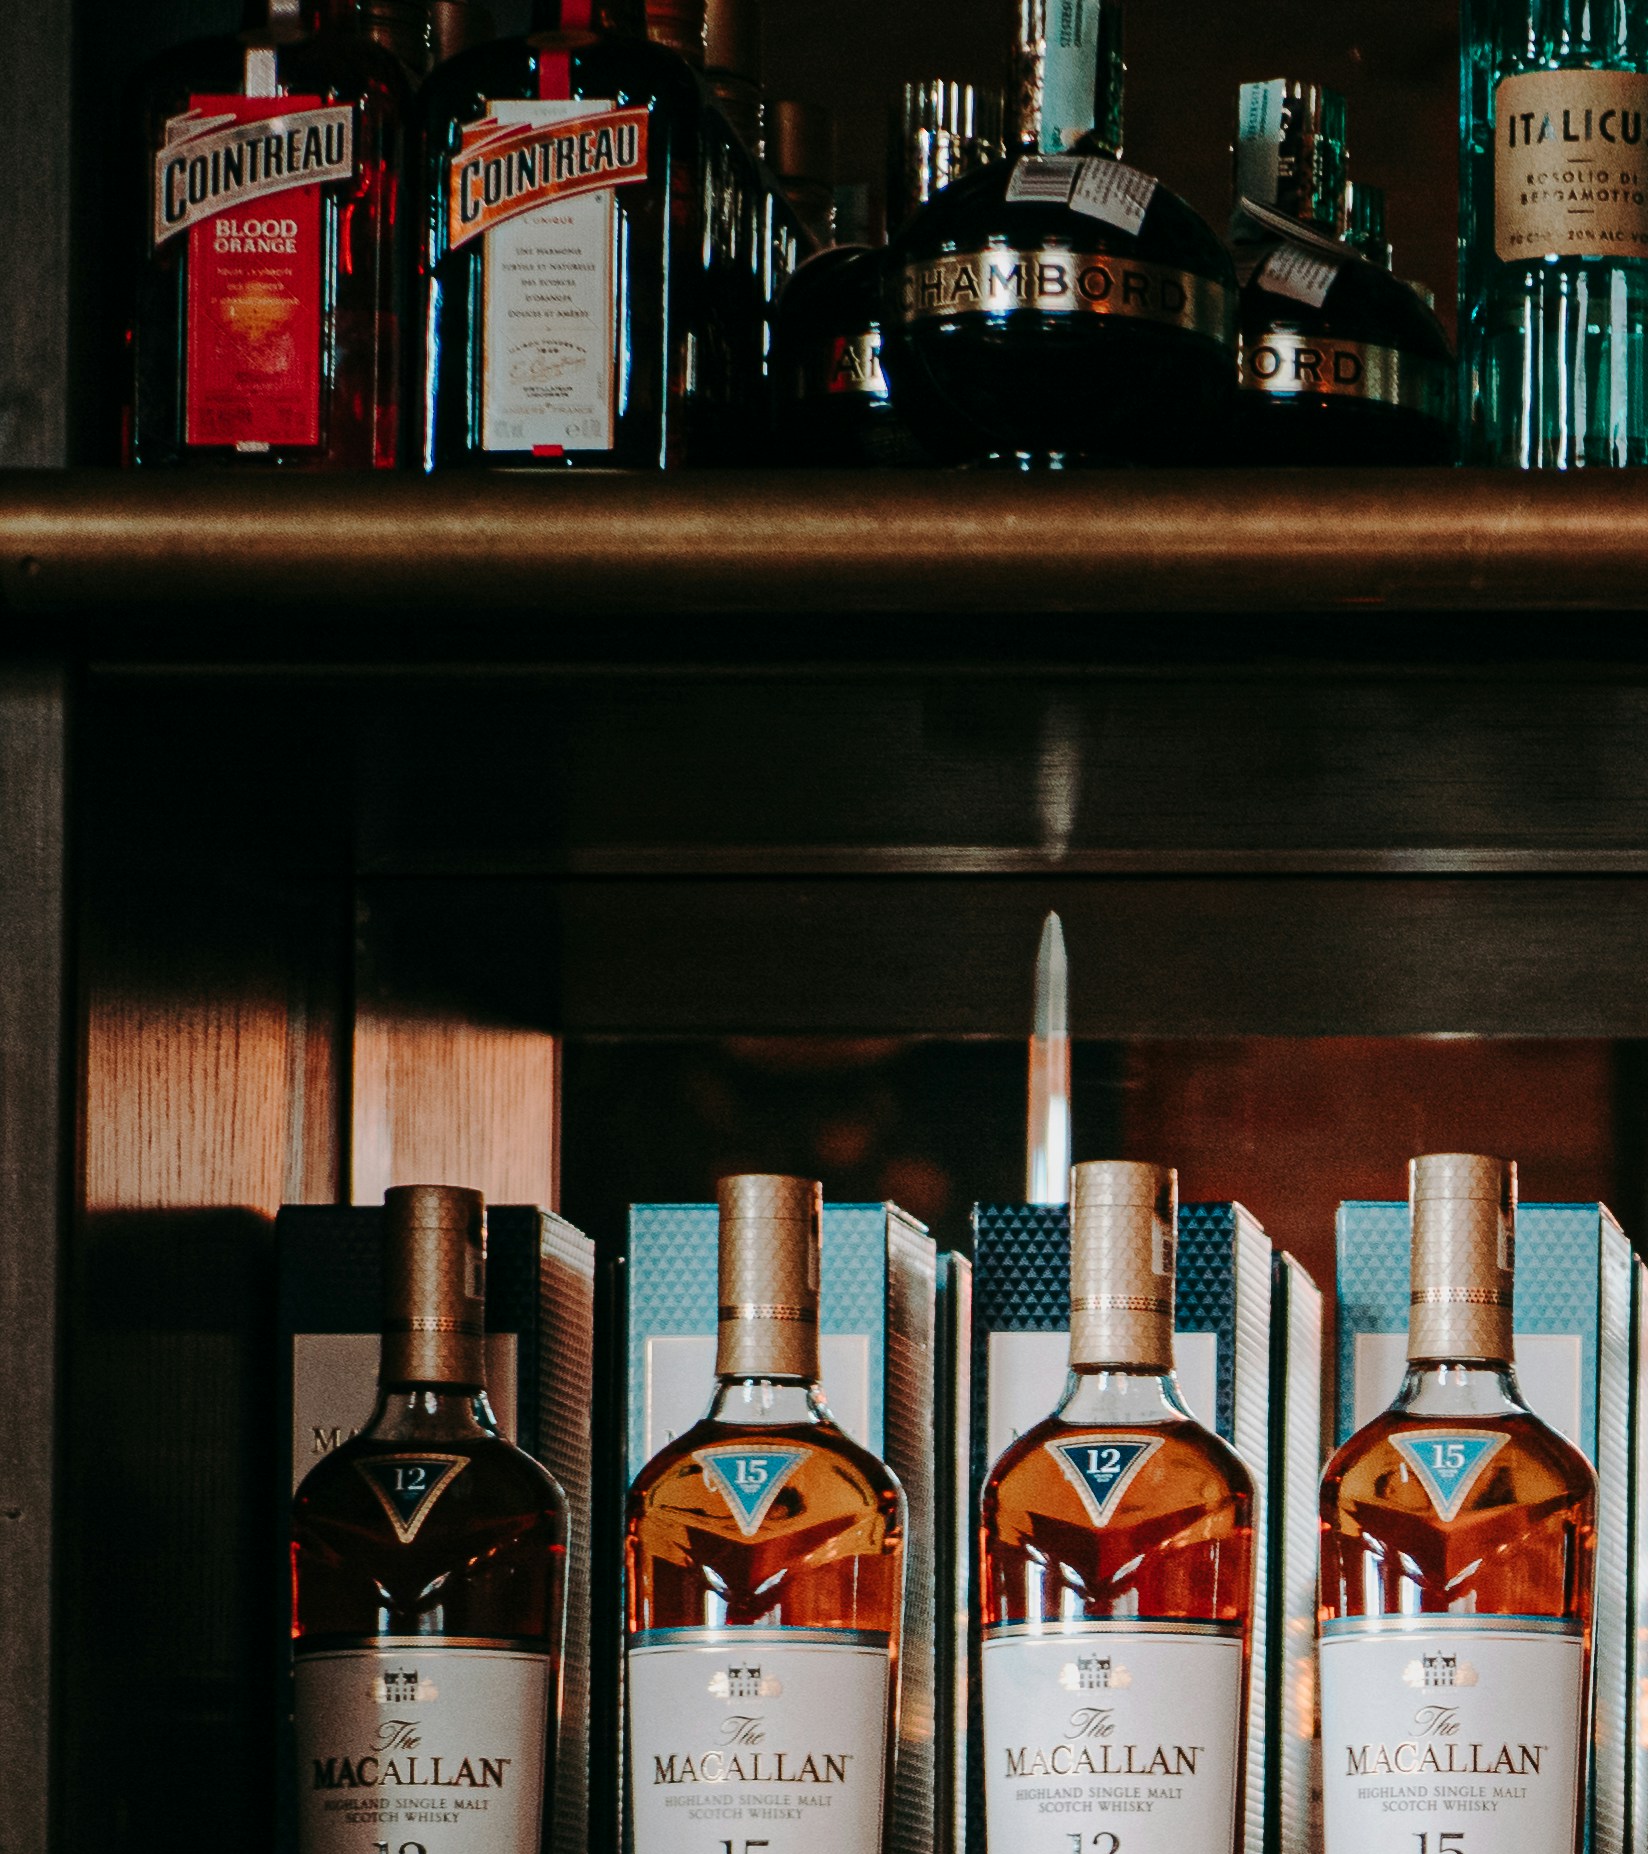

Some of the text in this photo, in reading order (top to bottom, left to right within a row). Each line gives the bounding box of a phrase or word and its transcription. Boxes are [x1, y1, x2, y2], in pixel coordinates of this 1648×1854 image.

[165, 122, 345, 223] COINTREAU
[461, 124, 638, 224] COINTREAU
[1527, 171, 1637, 185] ROSOLIO DI
[215, 218, 298, 238] BLOOD
[213, 238, 297, 254] ORANGE
[903, 263, 1187, 314] HAMBORD
[736, 1459, 769, 1485] 15
[1086, 1448, 1121, 1474] 12
[1432, 1444, 1466, 1469] 15
[395, 1467, 426, 1490] 12
[371, 1720, 423, 1752] The
[714, 1716, 765, 1746] The
[1065, 1707, 1116, 1739] The
[1409, 1705, 1460, 1737] The
[312, 1757, 507, 1788] MACALLAN
[654, 1753, 846, 1784] MACALLAN
[1005, 1744, 1199, 1778] MACALLAN
[1346, 1744, 1541, 1775] MACALLAN
